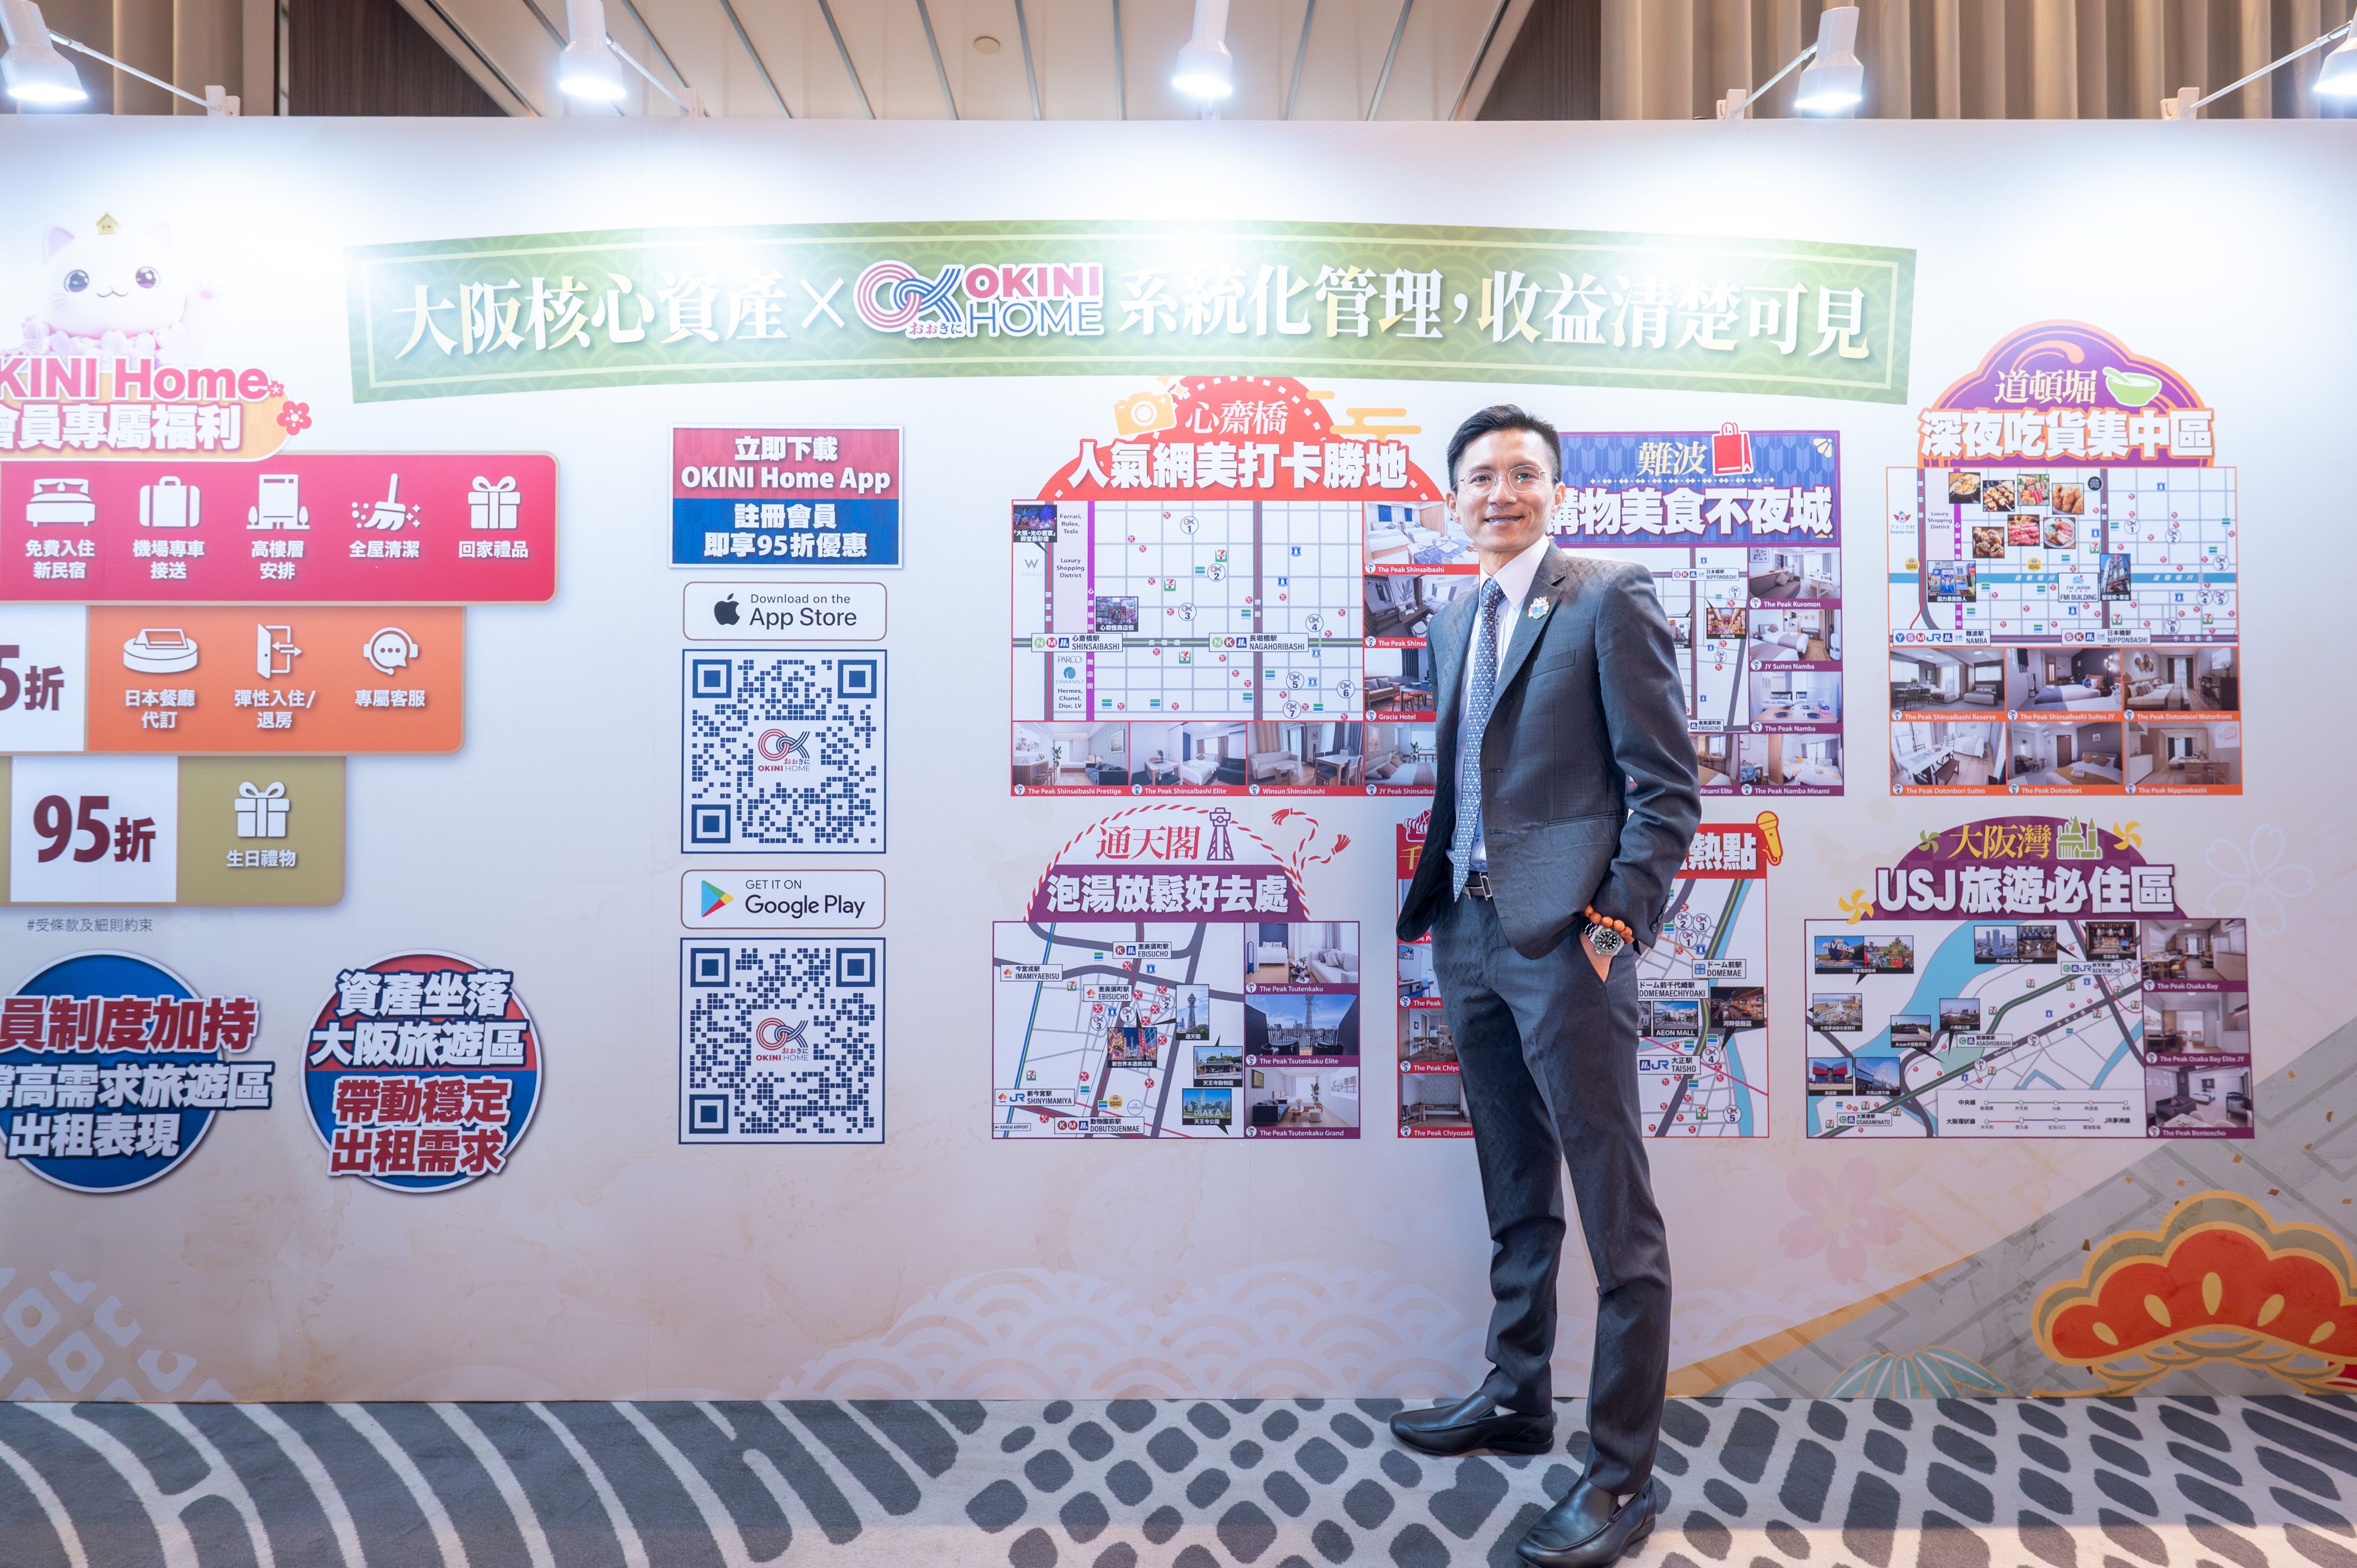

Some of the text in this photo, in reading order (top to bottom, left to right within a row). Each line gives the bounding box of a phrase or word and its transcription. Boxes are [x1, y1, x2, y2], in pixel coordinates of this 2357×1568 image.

[965, 266, 1100, 298] OKINI
[392, 268, 790, 359] 大阪核心資產
[970, 301, 1101, 334] HOME
[909, 321, 963, 335] おおきに
[114, 358, 269, 400] Home
[1993, 369, 2098, 405] 道頓堀
[1920, 410, 2213, 458] 深夜吃貨集中區
[734, 435, 838, 461] 立即下載
[1636, 441, 1708, 476] 難波
[1067, 441, 1408, 489] 人氣網美打卡勝地
[681, 466, 890, 494] OKINI Home App
[734, 503, 837, 529] 註冊會員
[25, 539, 95, 559] 免費入住
[133, 539, 205, 559] 機場專車
[251, 539, 305, 559] 高樓層
[348, 540, 420, 559] 全屋清潔
[458, 540, 529, 559] 回家禮品
[704, 532, 867, 558] 即享95折優惠
[33, 560, 87, 580] 新民宿
[150, 561, 187, 580] 接送
[259, 561, 296, 580] 安排
[750, 593, 809, 603] Download
[831, 594, 850, 603] the
[749, 608, 857, 630] App Store
[125, 689, 196, 708] 日本餐廳
[235, 689, 316, 709] 彈性入住/
[355, 689, 425, 708] 專屬客服
[141, 711, 177, 729] 代訂
[256, 711, 293, 729] 退房
[33, 794, 156, 863] 95折
[1947, 824, 2052, 859] 大阪灣
[1095, 825, 1200, 861] 通天閣
[1679, 832, 1757, 871] 熱點
[226, 850, 296, 868] 生日禮物
[745, 880, 801, 889] GET IT ON
[1047, 874, 1289, 913] 泡湯放鬆好去處
[1877, 866, 2174, 914] USJ旅遊必住區
[745, 894, 866, 919] Google Play
[26, 917, 153, 933] #受條款及細則約束
[337, 971, 511, 1018] 資產坐落
[1639, 989, 1705, 998] DOMEMAECHIYOAKI
[0, 997, 256, 1052] 員制度加持
[309, 1022, 526, 1068] 大阪旅遊區
[336, 1077, 510, 1125] 帶動穩定
[8, 1113, 180, 1158] 出租表現
[331, 1127, 507, 1175] 出租需求
